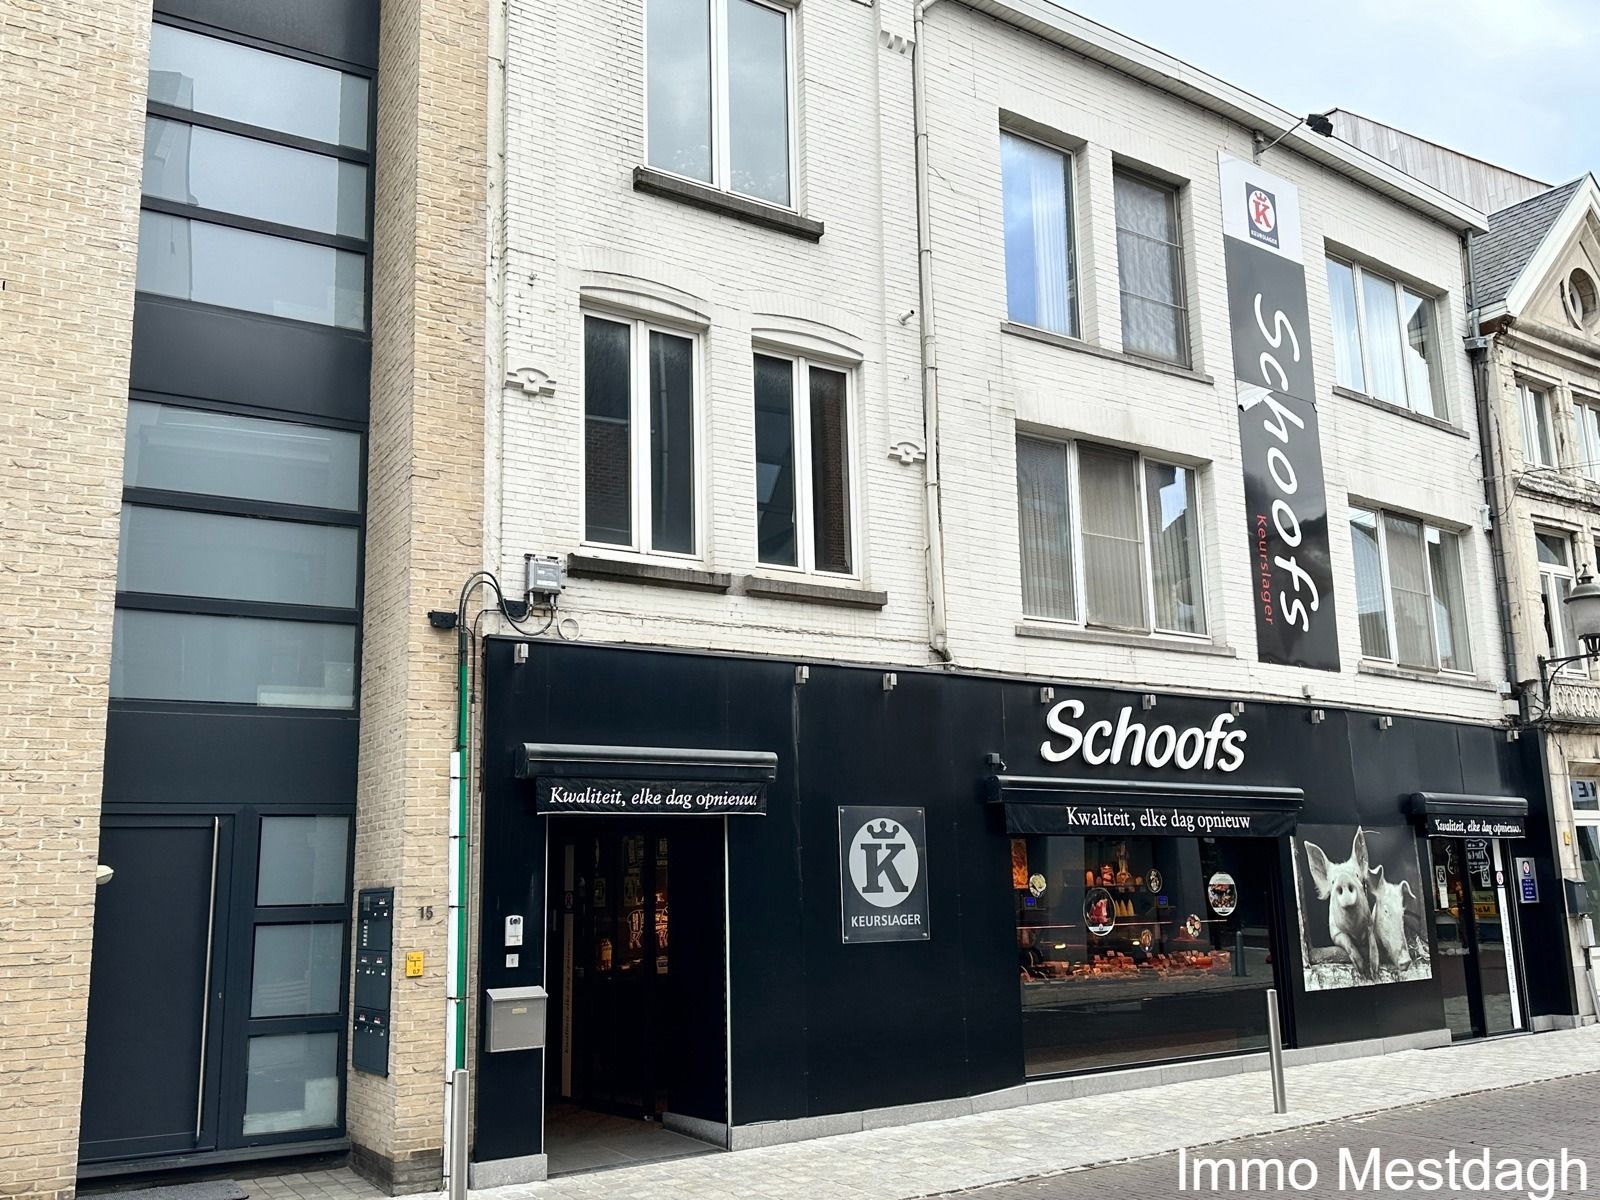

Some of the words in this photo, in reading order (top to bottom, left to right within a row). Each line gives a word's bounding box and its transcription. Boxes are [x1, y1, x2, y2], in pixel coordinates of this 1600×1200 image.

[1253, 199, 1272, 228] K
[1254, 293, 1320, 632] Schoofs
[1256, 514, 1273, 625] Keurslager
[1040, 699, 1248, 772] Schoofs
[550, 786, 626, 807] Kwaliteit,
[631, 788, 661, 805] elke
[665, 789, 692, 809] dag
[1066, 806, 1135, 830] Kwaliteit,
[1140, 808, 1167, 827] elke
[1171, 809, 1195, 832] dag
[1198, 811, 1250, 832] opnieuw
[860, 843, 909, 893] K
[418, 906, 433, 920] 15
[851, 914, 921, 927] KEURSLAGER
